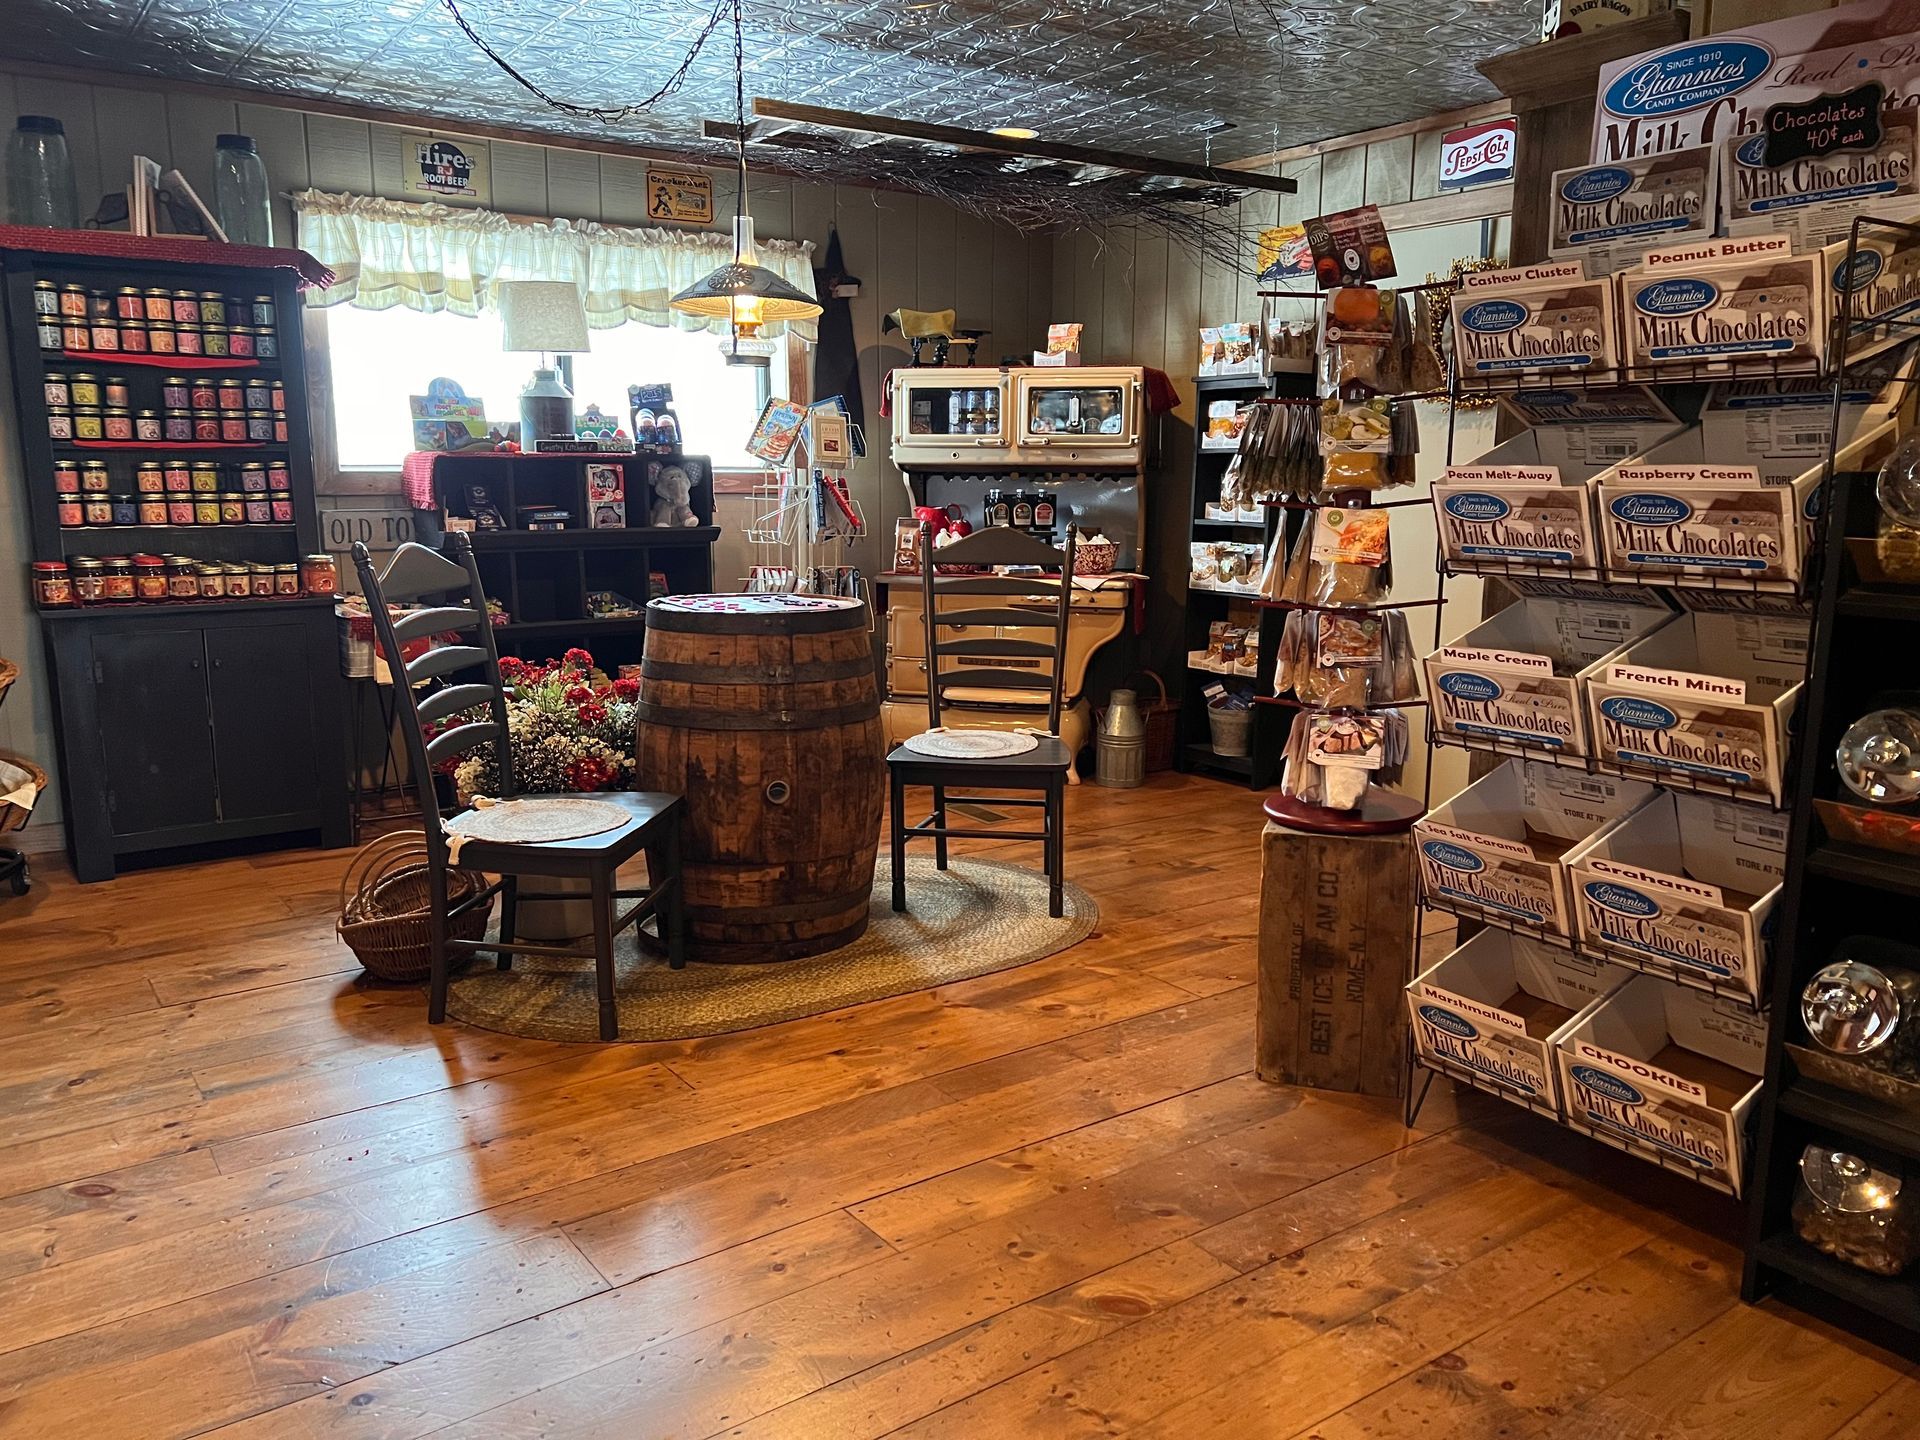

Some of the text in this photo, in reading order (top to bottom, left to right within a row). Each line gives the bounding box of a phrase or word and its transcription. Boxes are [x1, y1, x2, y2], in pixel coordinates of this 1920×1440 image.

[1570, 0, 1632, 17] DAIRY WAGON
[1666, 51, 1722, 71] SINCE 1910
[1764, 52, 1855, 90] Real
[1623, 56, 1748, 109] Giannios
[1645, 85, 1728, 110] CANDY COMPANY
[1773, 102, 1866, 132] Chocolates
[1604, 117, 1691, 163] Milk
[1806, 124, 1865, 149] 40¢ each
[415, 143, 475, 170] Hires
[423, 173, 468, 187] ROOT BEER
[1737, 169, 1787, 200] Milk
[1792, 156, 1910, 192] Chocolates
[1560, 204, 1602, 233] Milk
[1605, 195, 1701, 226] Chocolates
[1309, 230, 1330, 245] DIPS
[1648, 239, 1786, 265] Peanut Butter
[1468, 265, 1578, 287] Cashew Cluster
[1646, 284, 1706, 310] Giannios
[1471, 303, 1519, 326] Giannios
[1638, 310, 1807, 349] Milk Chocolates
[1465, 328, 1601, 360] Milk Chocolates
[1448, 470, 1553, 482] Pecan Melt-Away
[1619, 469, 1753, 481] Raspberry Cream
[1454, 495, 1501, 515] Giannios
[1621, 496, 1680, 518] Giannios
[331, 517, 415, 544] OLD TO
[1450, 518, 1581, 550] Milk Chocolates
[1614, 521, 1778, 559] Milk Chocolates
[1443, 649, 1548, 667] Maple Cream
[1447, 674, 1494, 695] Giannios
[1614, 668, 1742, 696] French Mints
[1442, 693, 1482, 723] Milk
[1483, 700, 1572, 736] Chocolates
[1611, 699, 1666, 724] Giannios
[1604, 718, 1651, 752] Milk
[1653, 728, 1762, 772] Chocolates
[1564, 808, 1585, 819] STORE
[1586, 813, 1593, 821] AT
[1427, 824, 1529, 855] Sea Salt Caramel
[1431, 843, 1475, 867] Giannios
[1736, 857, 1761, 871] STORE
[1763, 864, 1772, 874] AT
[1316, 866, 1340, 899] CO.
[1428, 860, 1465, 891] Milk
[1467, 872, 1553, 916] Chocolates
[1591, 861, 1713, 898] Grahams
[1595, 884, 1650, 912] Giannios
[1587, 903, 1633, 940] Milk
[1636, 918, 1741, 972] Chocolates
[1289, 921, 1304, 1000] PROPERTY OF
[1312, 974, 1334, 1005] ICE
[1424, 987, 1523, 1030] Marshmallow
[1426, 1008, 1470, 1038] Giannios
[1310, 1008, 1332, 1056] BEST
[1423, 1022, 1460, 1056] Milk
[1461, 1037, 1544, 1091] Chocolates
[1581, 1045, 1701, 1096] CHOOKIES
[1580, 1067, 1633, 1101] Giannios
[1575, 1082, 1618, 1121] Milk
[1621, 1103, 1724, 1163] Chocolates
